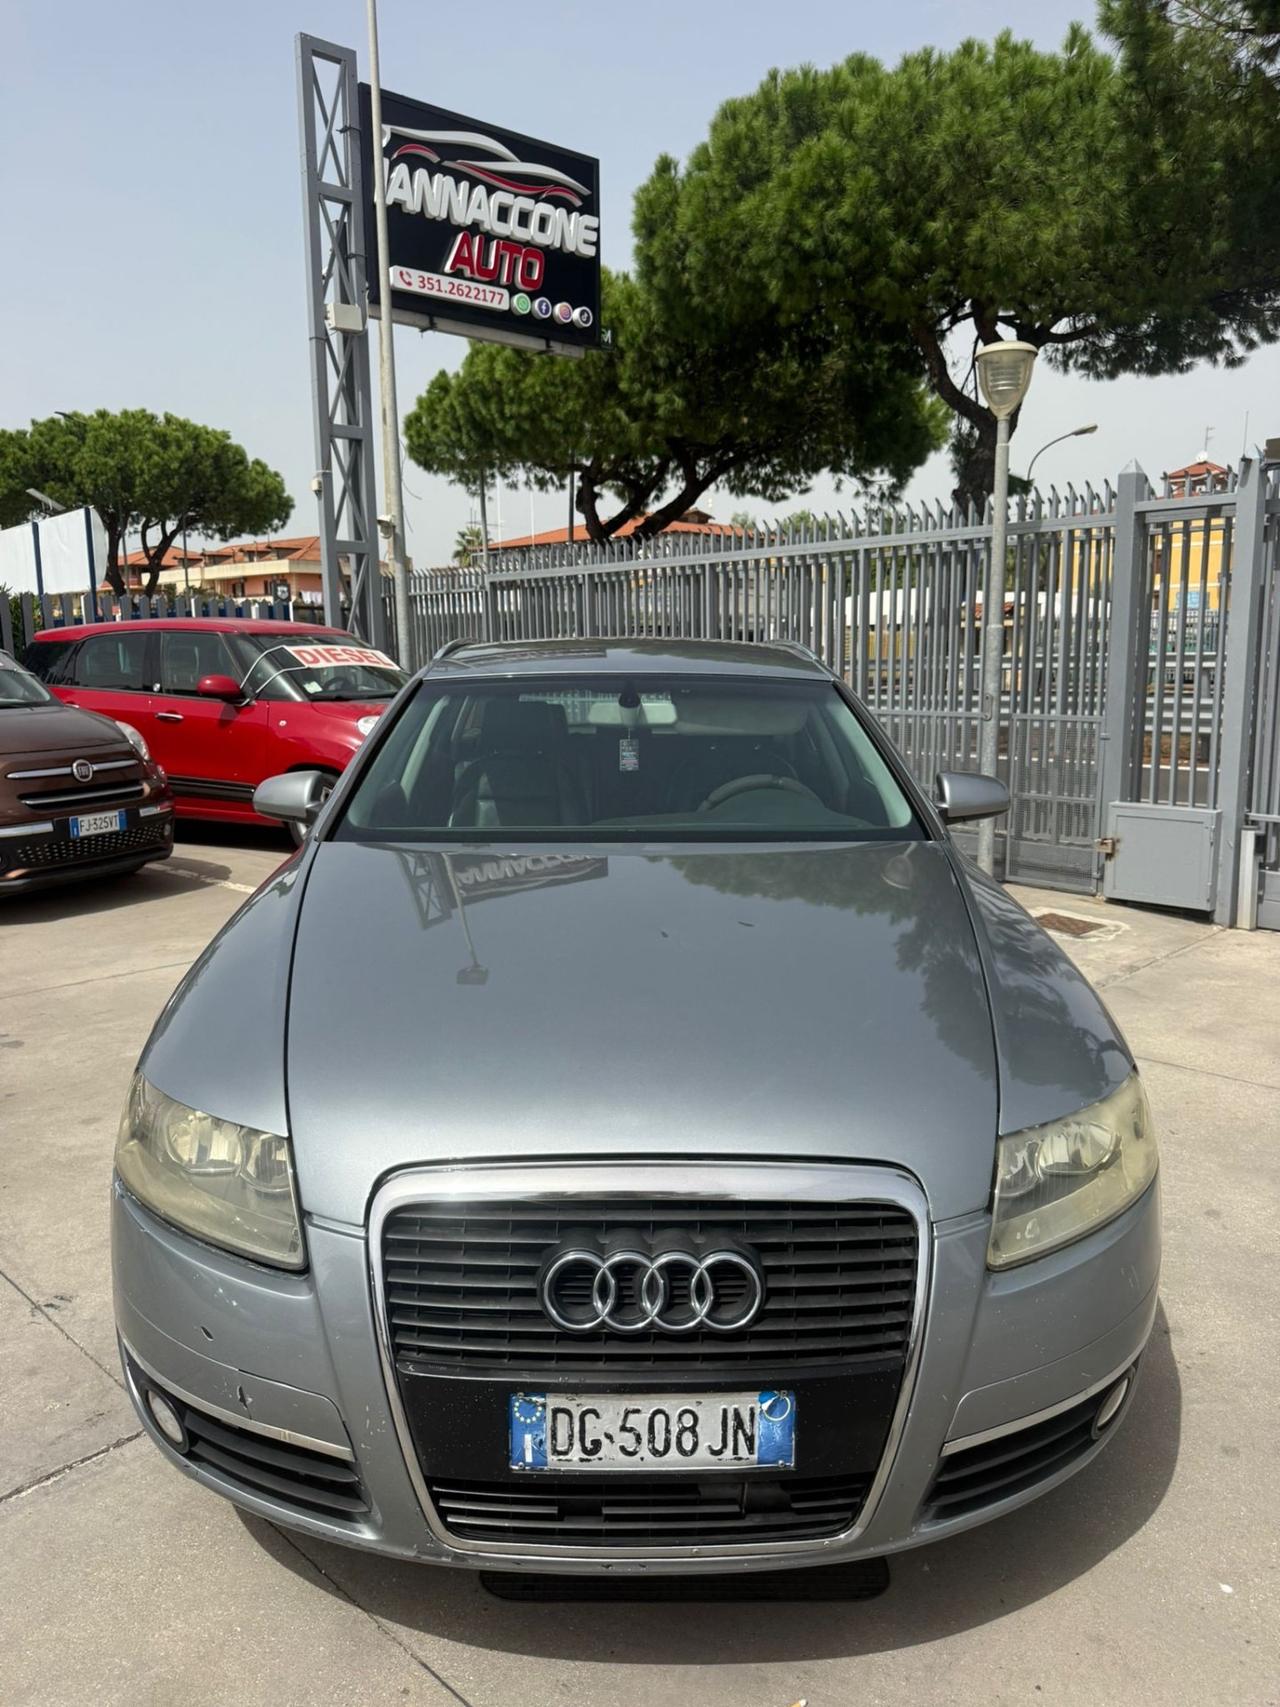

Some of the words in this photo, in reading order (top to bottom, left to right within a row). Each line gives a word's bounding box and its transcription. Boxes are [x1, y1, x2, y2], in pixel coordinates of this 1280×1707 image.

[445, 230, 545, 291] AUTO
[417, 275, 504, 305] 351.2622177
[292, 647, 393, 667] DIESEL
